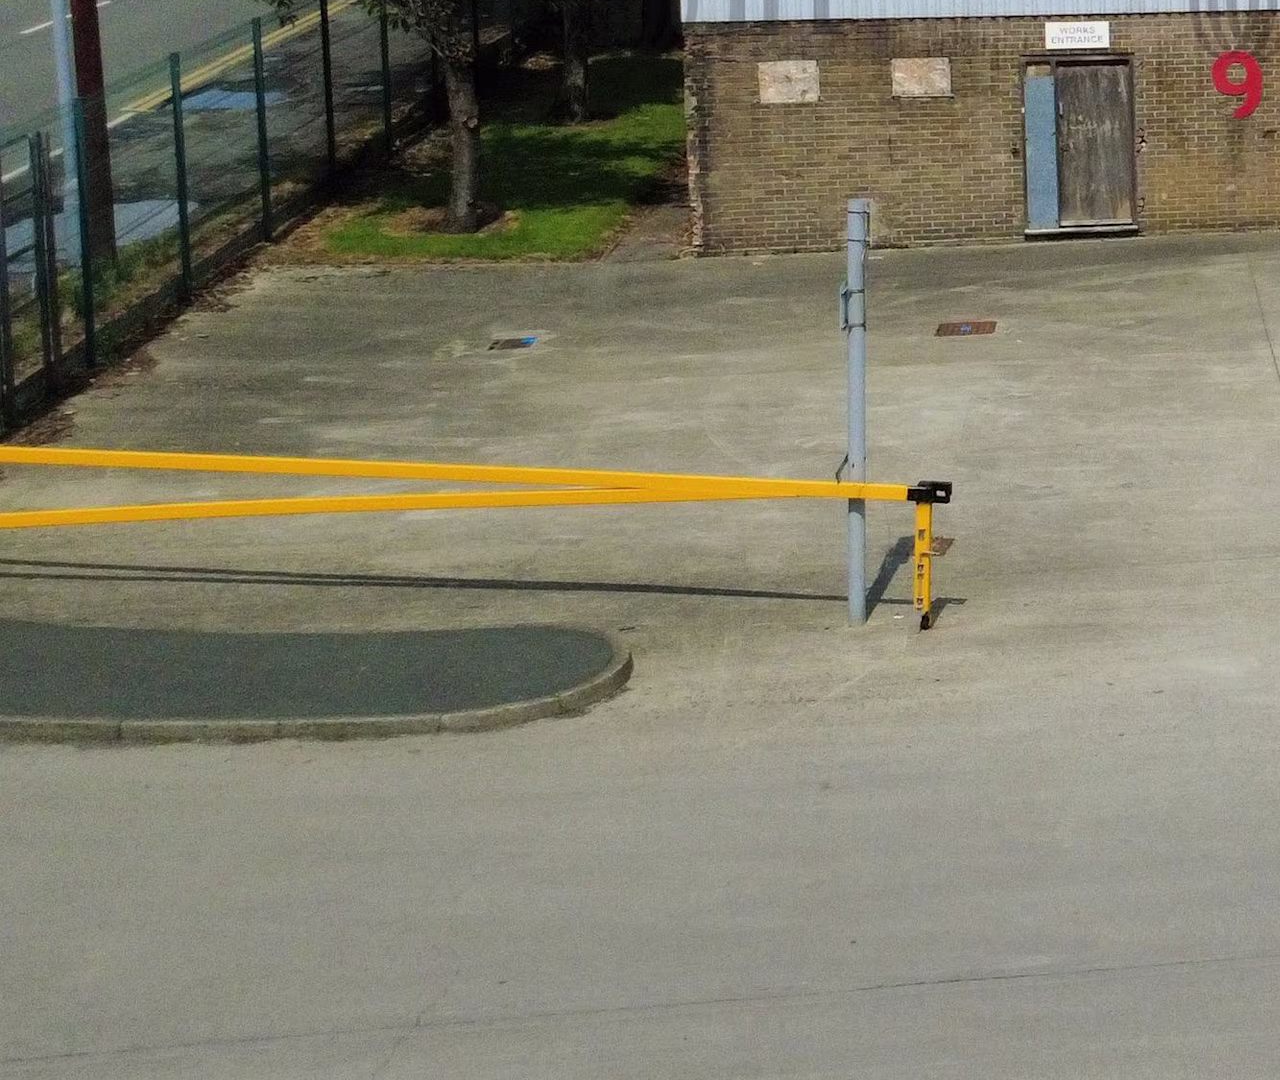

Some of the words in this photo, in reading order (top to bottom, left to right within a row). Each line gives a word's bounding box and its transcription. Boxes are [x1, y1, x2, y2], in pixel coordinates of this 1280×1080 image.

[1060, 26, 1096, 35] WORKS
[1051, 35, 1104, 44] ENTRANCE
[1211, 50, 1263, 118] 9
